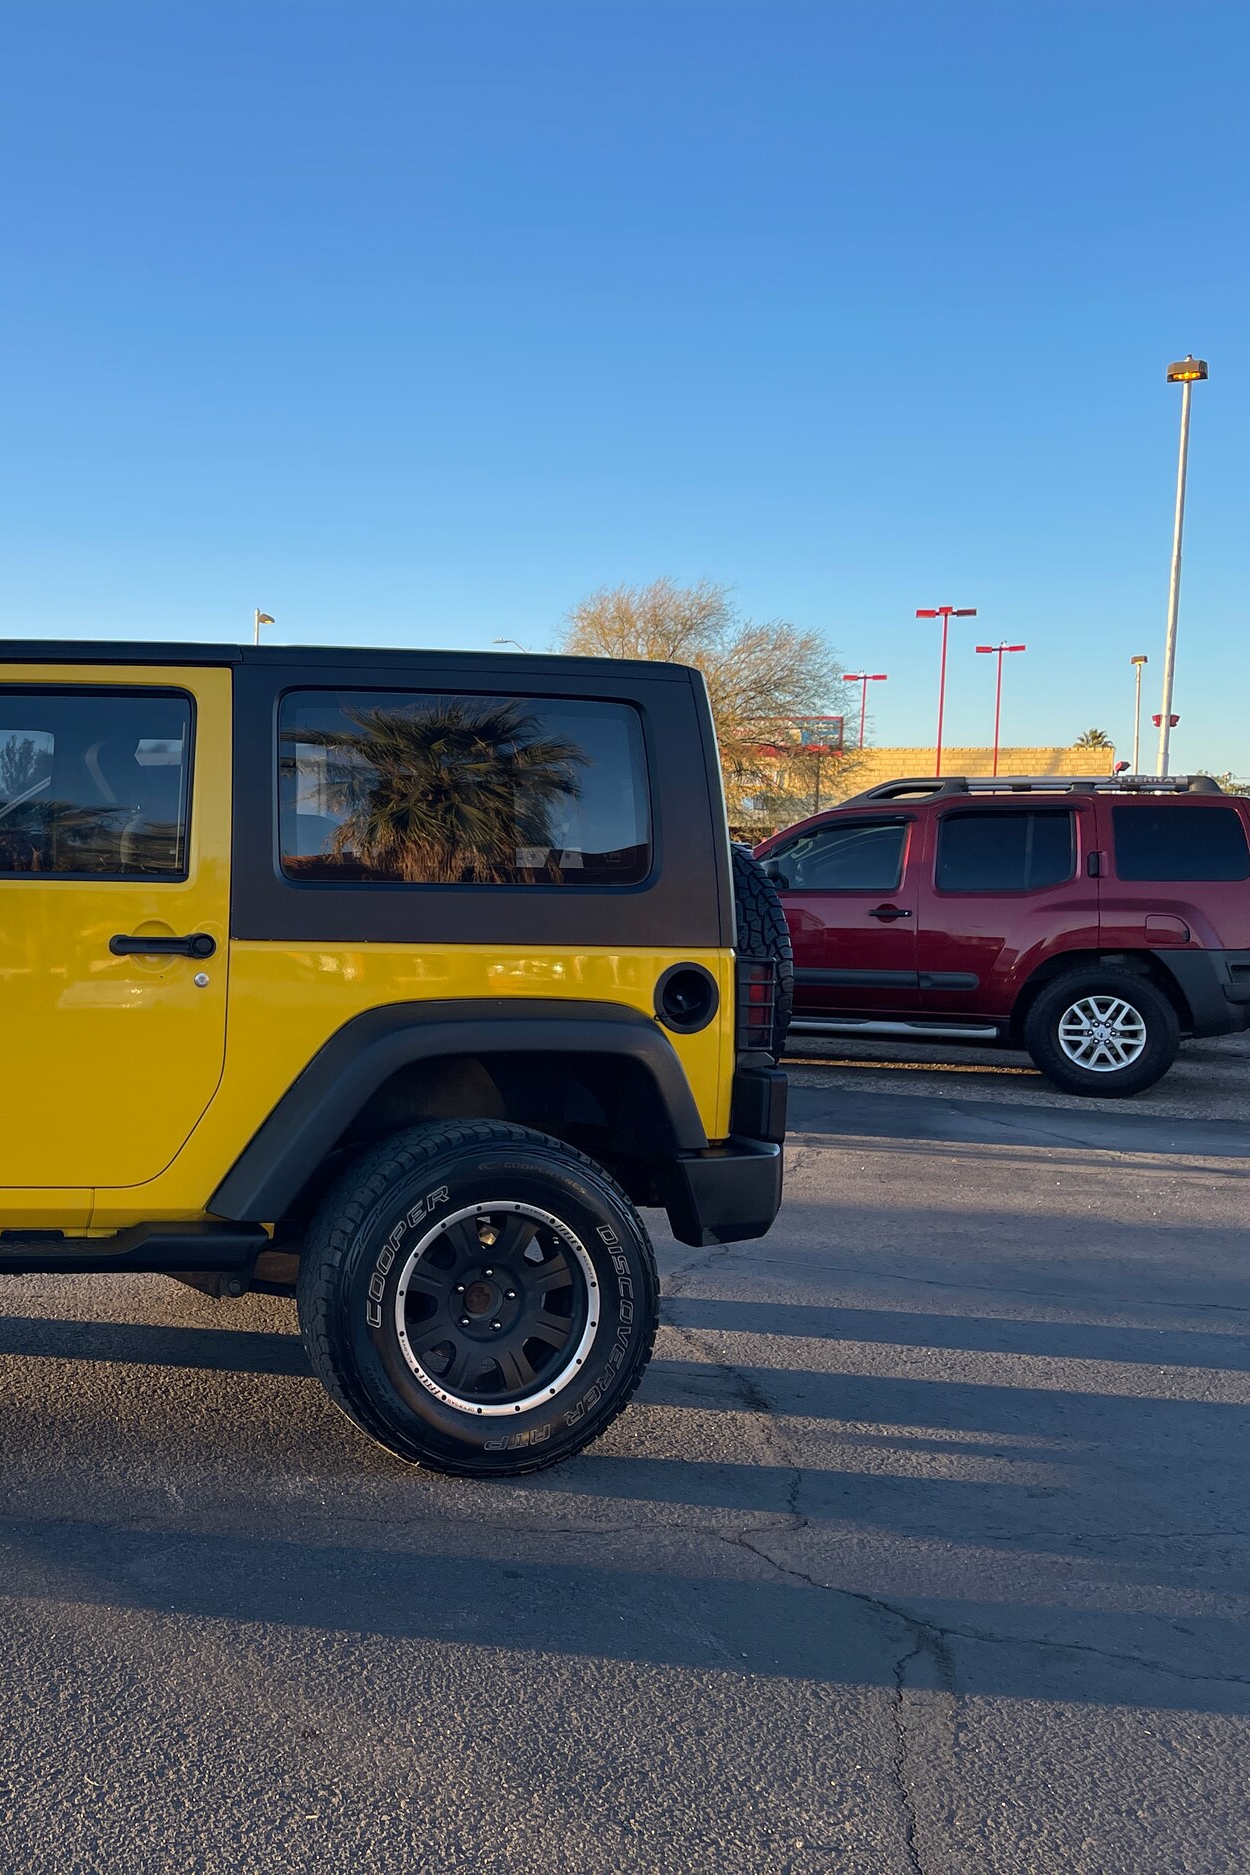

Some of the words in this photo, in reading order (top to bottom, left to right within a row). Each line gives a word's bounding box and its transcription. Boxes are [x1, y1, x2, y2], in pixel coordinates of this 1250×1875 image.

[365, 1184, 450, 1329] COOPER
[564, 1223, 635, 1427] DISCOVERER
[483, 1423, 551, 1451] ATP
